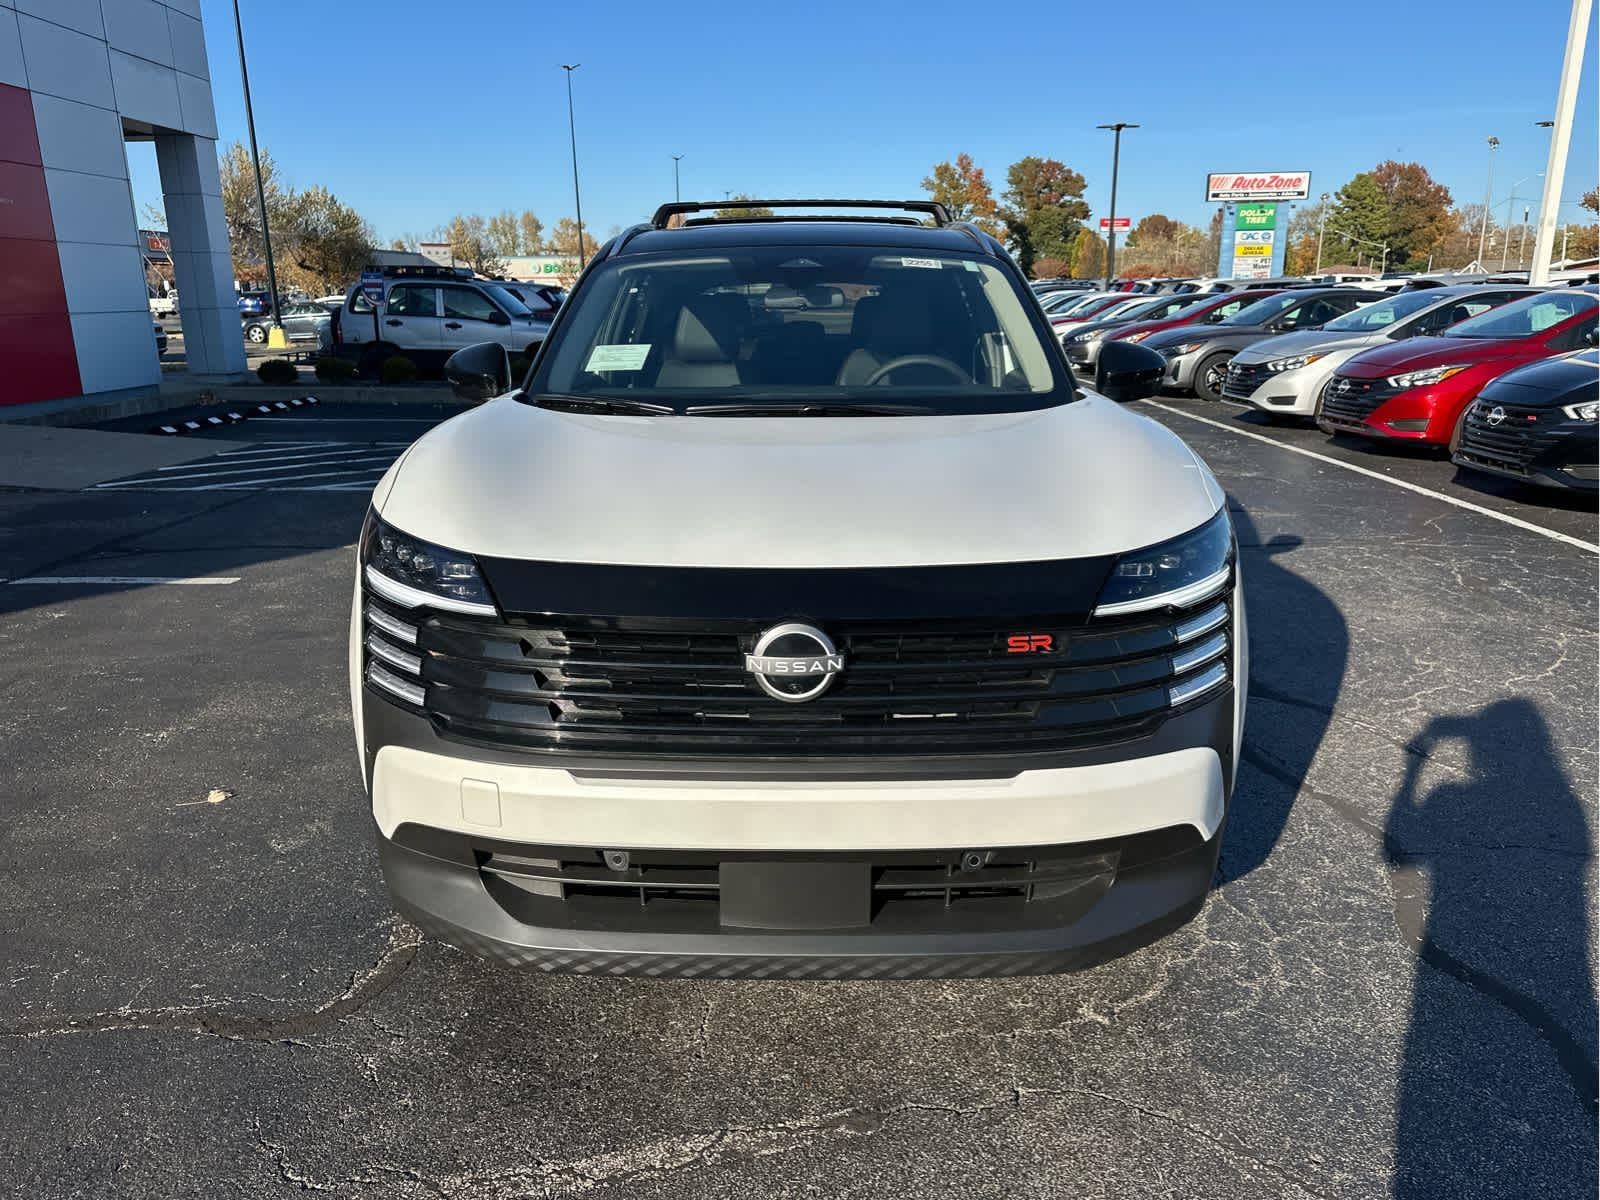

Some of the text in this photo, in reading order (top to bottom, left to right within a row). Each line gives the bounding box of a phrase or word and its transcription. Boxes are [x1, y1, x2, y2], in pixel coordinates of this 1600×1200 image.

[1231, 175, 1302, 189] AutoZone
[1007, 634, 1053, 653] SR
[749, 658, 843, 673] NISSAN
